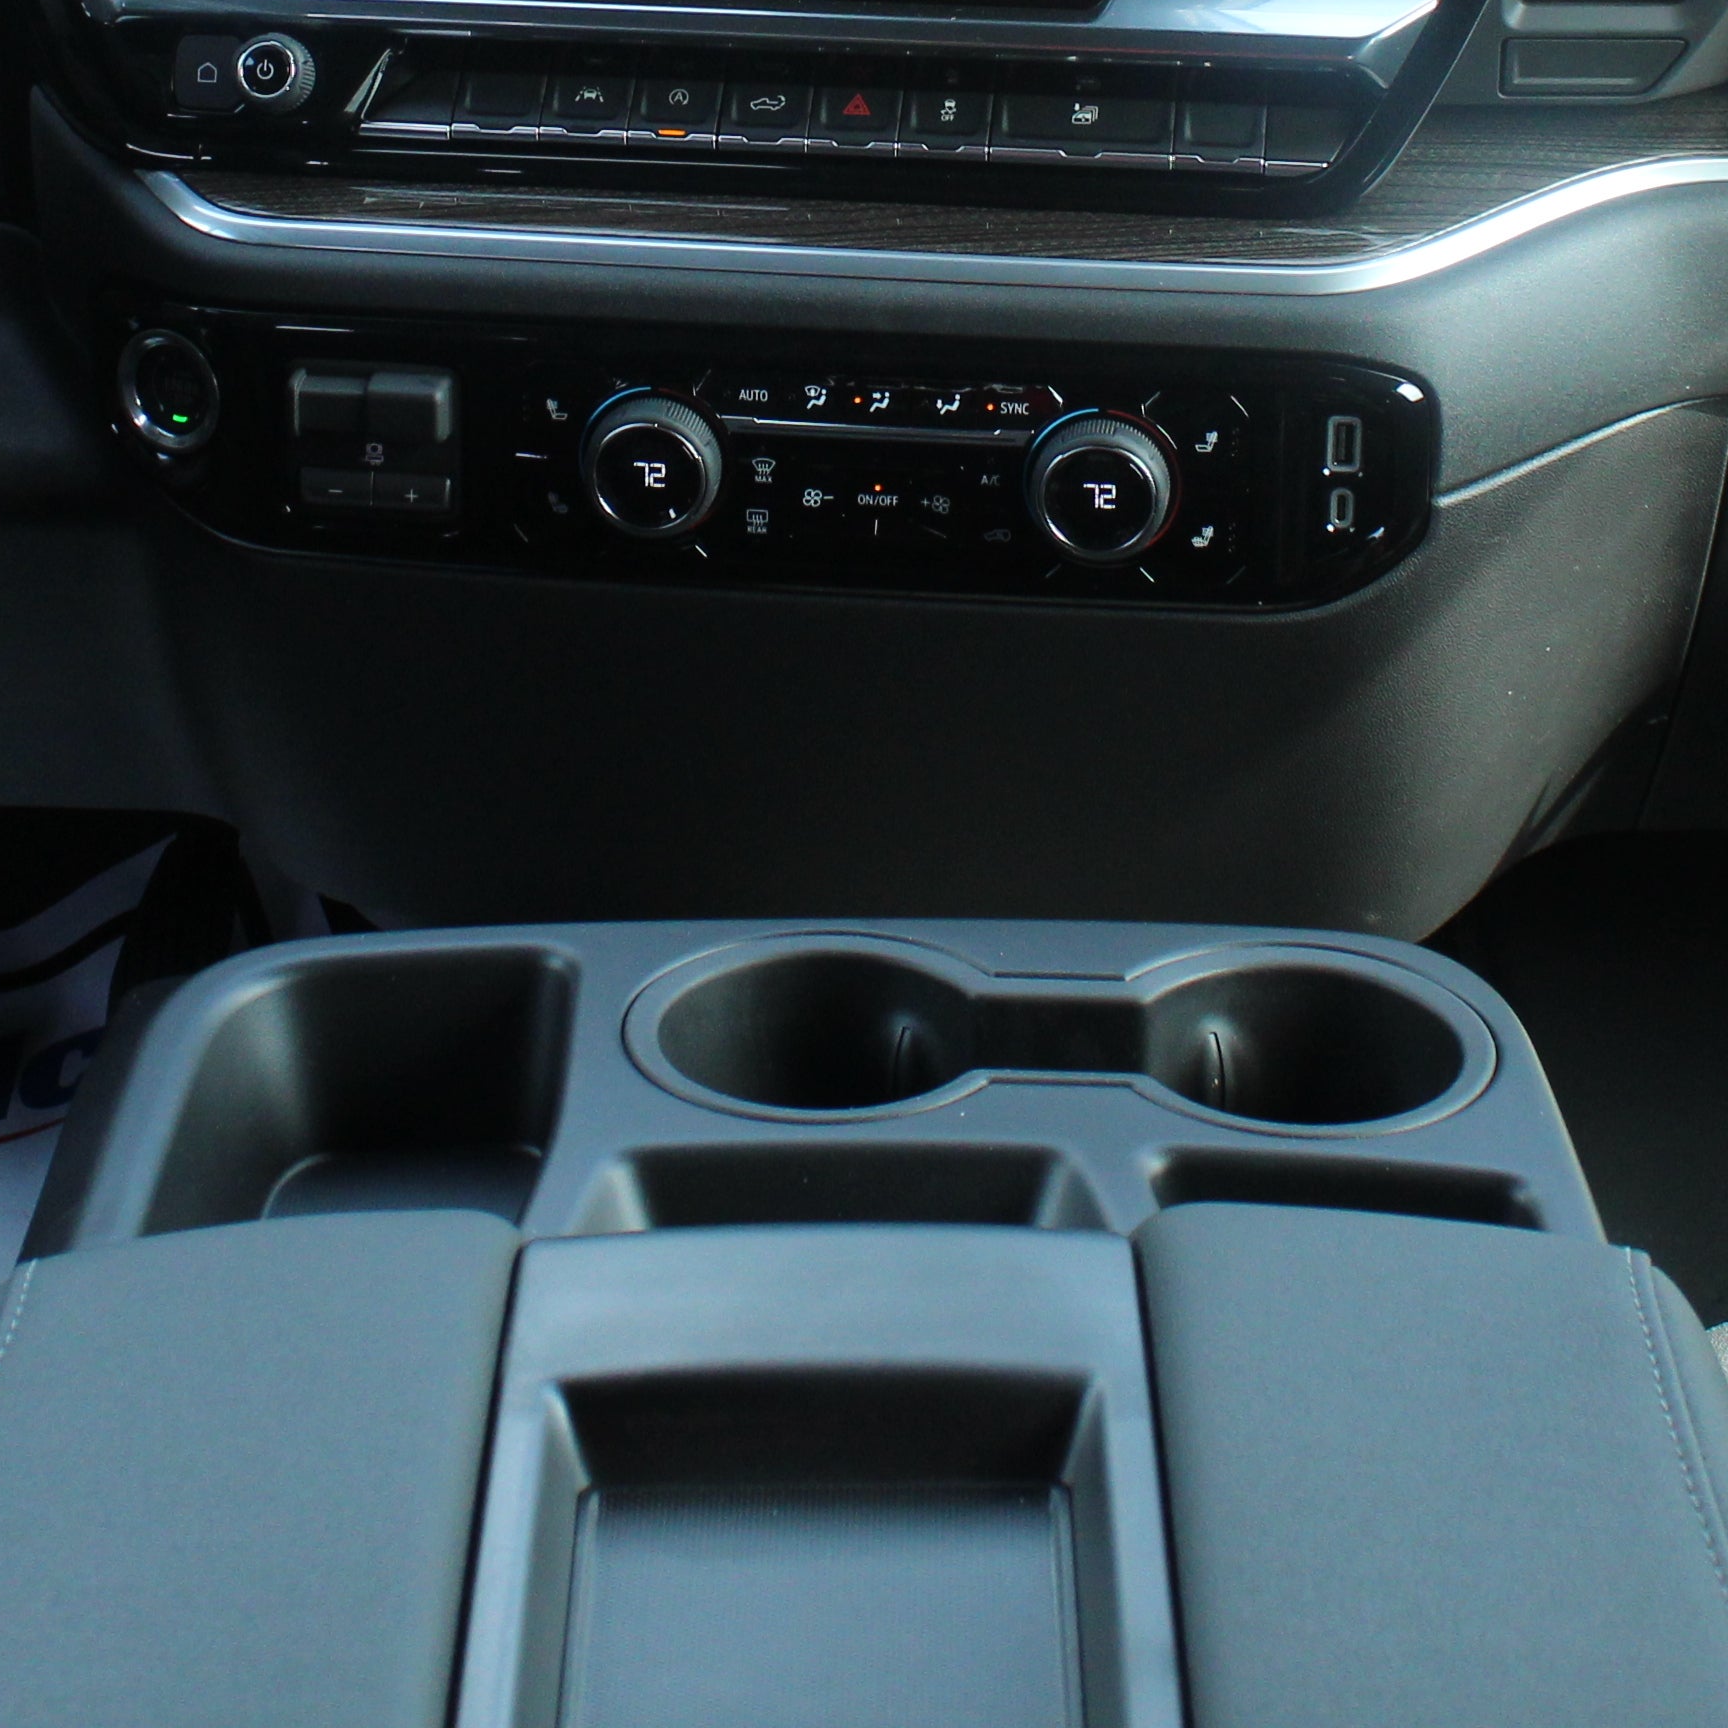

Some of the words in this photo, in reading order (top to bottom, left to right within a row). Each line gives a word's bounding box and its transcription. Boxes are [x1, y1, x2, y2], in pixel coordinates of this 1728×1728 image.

[941, 114, 955, 122] OFF
[739, 389, 768, 402] AUTO
[1001, 402, 1029, 414] SYNC
[634, 462, 665, 488] 72
[981, 475, 1000, 486] A/C
[857, 495, 899, 506] ON/OFF
[1084, 484, 1116, 509] 72
